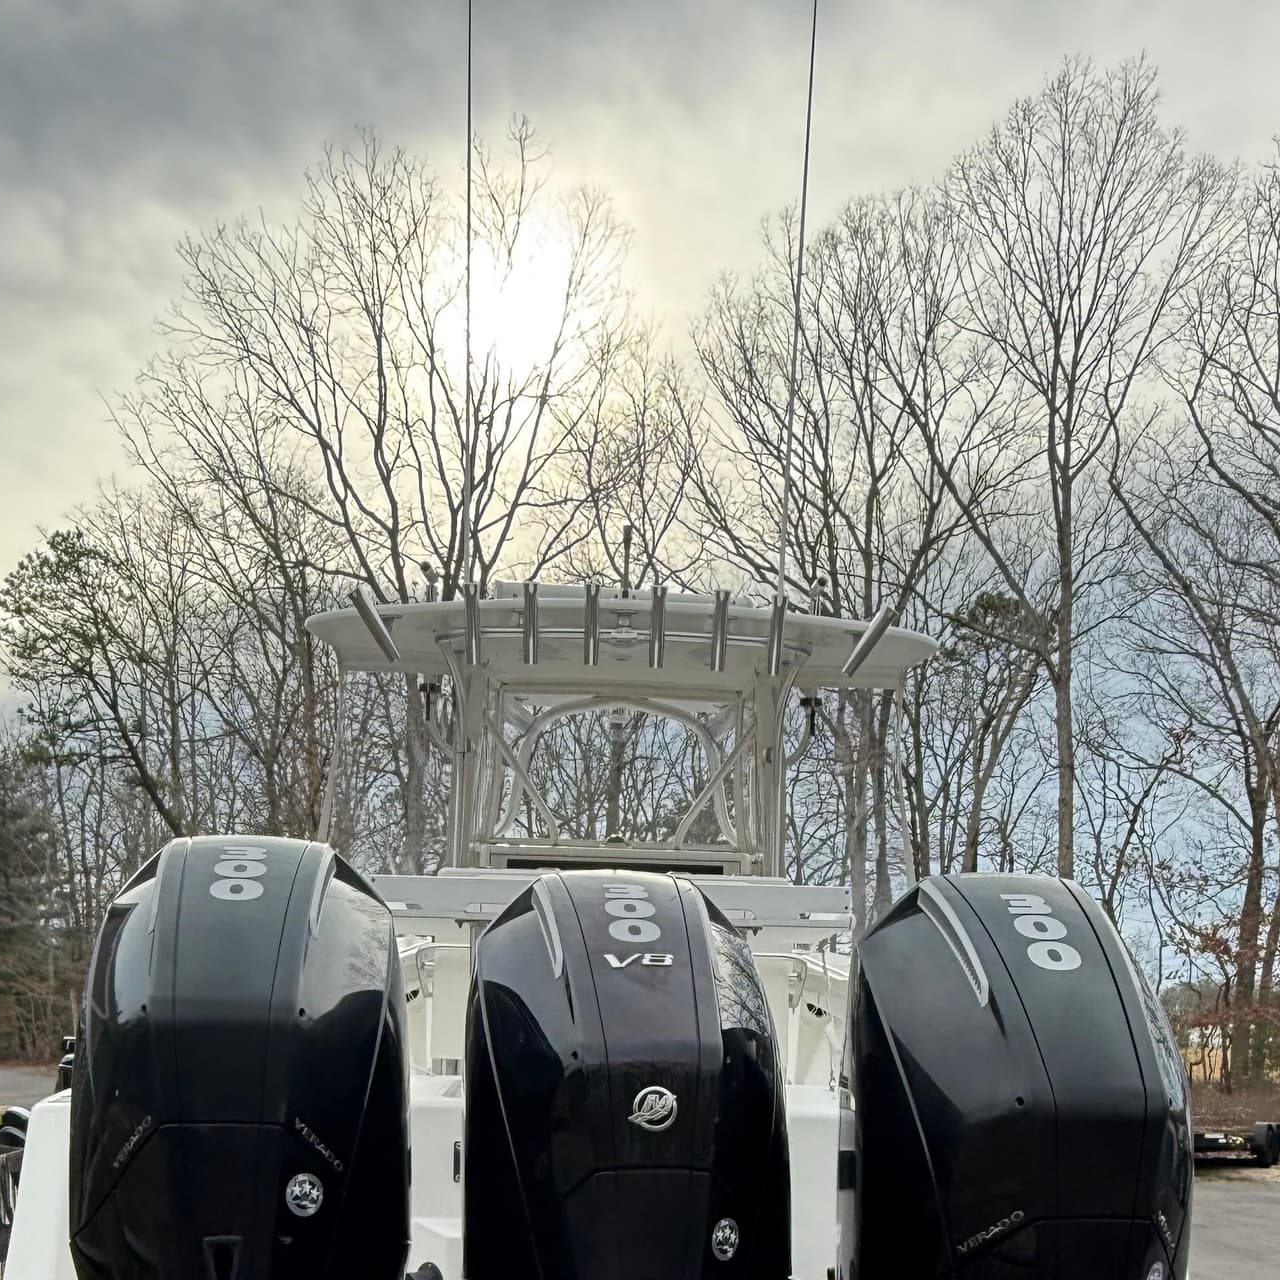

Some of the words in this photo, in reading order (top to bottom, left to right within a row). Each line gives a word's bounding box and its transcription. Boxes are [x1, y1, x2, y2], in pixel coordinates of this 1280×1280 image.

[210, 846, 267, 900] 300
[602, 884, 661, 942] 300
[1000, 894, 1082, 971] 300
[603, 953, 674, 968] V8
[295, 1117, 343, 1170] VERADO
